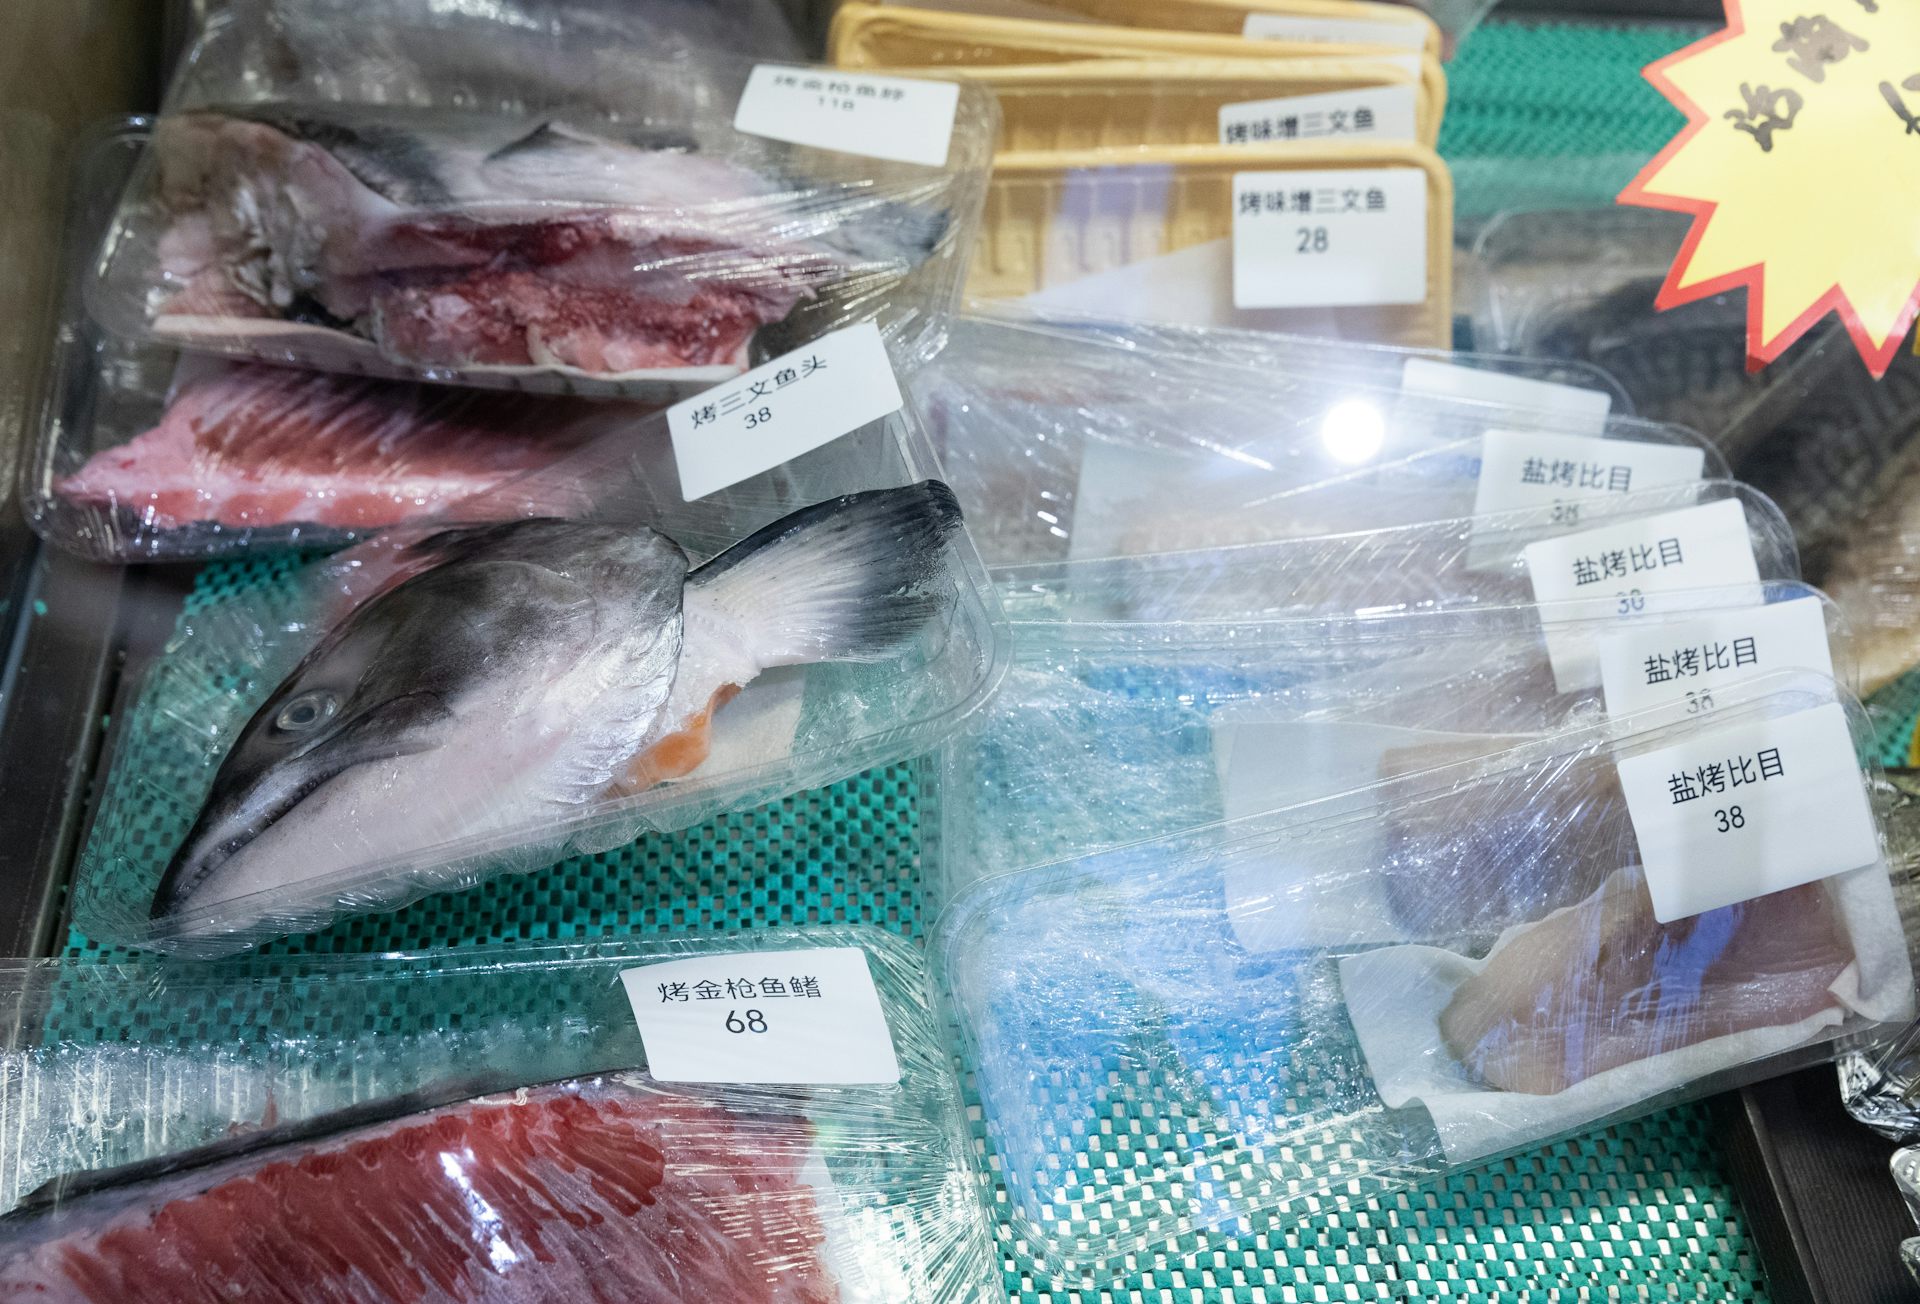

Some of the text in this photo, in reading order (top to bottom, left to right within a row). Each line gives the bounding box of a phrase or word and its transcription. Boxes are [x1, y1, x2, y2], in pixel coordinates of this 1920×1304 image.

[1296, 226, 1330, 253] 28
[691, 355, 828, 429] 烤三文鱼头
[744, 406, 773, 430] 38
[1521, 456, 1633, 492] 盐烤比目
[1572, 537, 1684, 586] 盐烤比目
[1644, 636, 1758, 685] 盐烤比目
[1667, 747, 1785, 805] 盐烤比目
[1713, 805, 1746, 833] 38
[657, 975, 823, 1003] 烤金枪鱼鳍
[725, 1009, 768, 1034] 68
